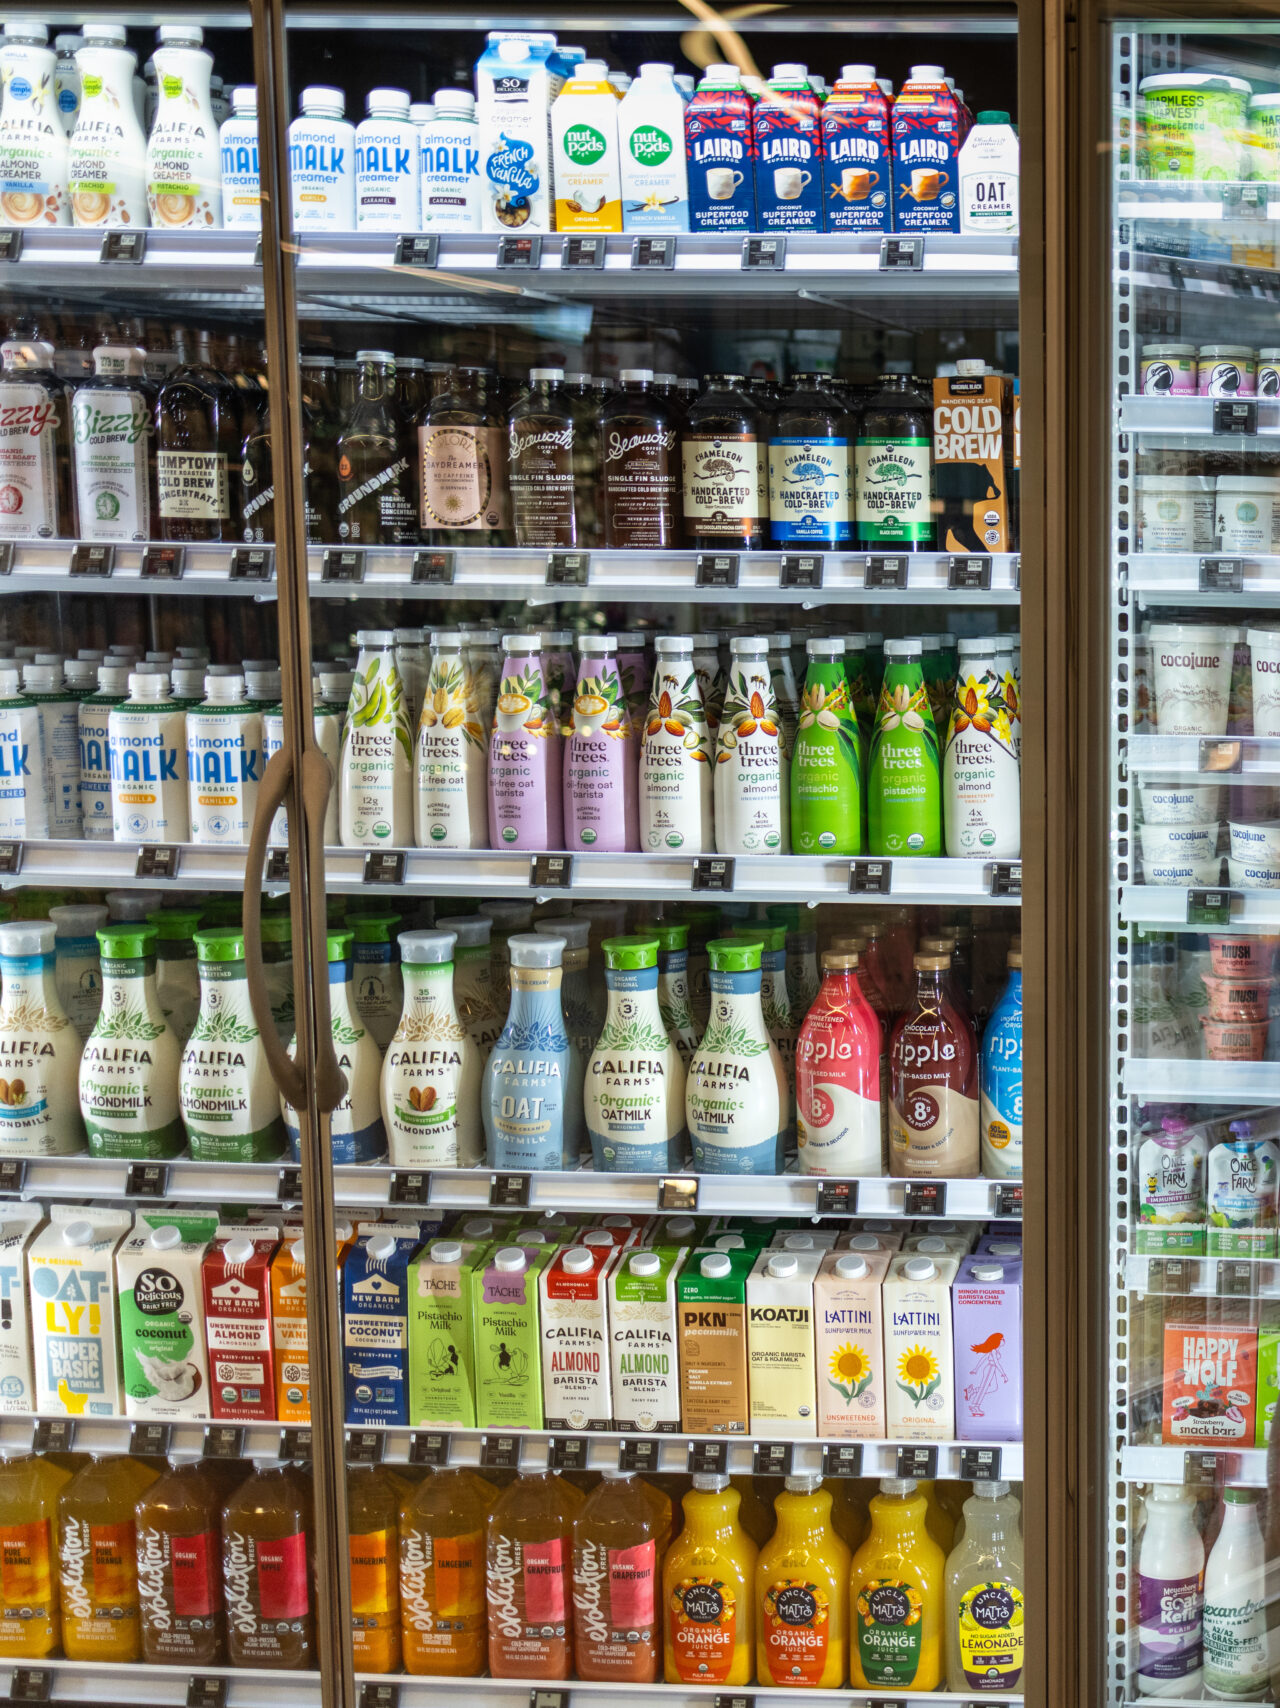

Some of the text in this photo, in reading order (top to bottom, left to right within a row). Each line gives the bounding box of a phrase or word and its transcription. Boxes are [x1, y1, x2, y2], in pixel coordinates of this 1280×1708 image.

[502, 77, 521, 89] SO
[837, 83, 872, 91] CINNAMON
[358, 133, 401, 146] almond
[567, 130, 592, 147] nut
[694, 137, 744, 162] LAIRD
[492, 149, 529, 170] FRENCH
[358, 173, 400, 186] creamer
[975, 181, 1006, 205] OAT
[695, 211, 749, 223] SUPERFOOD
[73, 402, 154, 444] Bizzy
[935, 404, 1001, 434] COLD
[89, 433, 127, 446] COLD BREW
[509, 426, 577, 462] Seaworth
[934, 434, 1001, 461] BREW
[695, 449, 743, 463] CHAMELEON
[427, 461, 484, 470] DAYDREAMER
[508, 474, 575, 482] SINGLE FIN SLUDGE
[338, 457, 410, 515] GROUNDWORK
[691, 486, 750, 497] HANDCRAFTED
[695, 495, 745, 505] COLD-BREW
[1160, 651, 1220, 670] cocojune
[350, 731, 392, 746] three
[350, 760, 394, 773] organic
[569, 767, 610, 778] organic
[362, 774, 379, 785] soy
[566, 780, 613, 790] oil-free oat
[573, 789, 604, 799] barista
[883, 785, 927, 796] pistachio
[363, 797, 379, 807] 12g
[904, 1025, 939, 1033] CHOCOLATE
[892, 1039, 957, 1067] ripple
[593, 1060, 665, 1076] CALIFIA
[606, 1077, 651, 1087] FARMS
[600, 1092, 654, 1109] Organic
[500, 1095, 545, 1121] OAT
[602, 1108, 652, 1122] OATMILK
[914, 1101, 931, 1118] 8g
[393, 1119, 461, 1137] ALMONDMILK
[142, 1274, 178, 1293] SO
[136, 1289, 182, 1302] Delicious
[211, 1299, 260, 1308] NEW BARN
[45, 1302, 101, 1336] LY!
[418, 1311, 463, 1325] Pistachio
[684, 1312, 727, 1327] PKN
[750, 1308, 809, 1324] KOATJI
[825, 1309, 872, 1324] LATTINI
[210, 1322, 265, 1331] UNSWEETENED
[430, 1320, 452, 1331] Milk
[824, 1327, 857, 1335] SUNFLOWER
[136, 1326, 188, 1340] coconut
[215, 1330, 261, 1340] ALMOND
[684, 1328, 739, 1338] pecanmilk
[49, 1339, 99, 1361] SUPER
[1183, 1336, 1239, 1360] HAPPY
[552, 1351, 600, 1374] ALMOND
[52, 1360, 99, 1380] BASIC
[1183, 1360, 1238, 1386] WOLF
[553, 1377, 598, 1386] BARISTA
[1193, 1418, 1224, 1427] Strawberry
[1179, 1425, 1236, 1436] snack bars
[351, 1556, 387, 1566] TANGERINE
[612, 1569, 651, 1580] GRAPEFRUIT
[487, 1534, 521, 1638] evolution
[873, 1587, 905, 1601] UNCLE
[1161, 1596, 1198, 1612] Goat
[1161, 1609, 1196, 1625] Kefir
[1168, 1626, 1191, 1635] PLAIN
[863, 1635, 916, 1648] ORANGE
[961, 1637, 1024, 1650] LEMONADE
